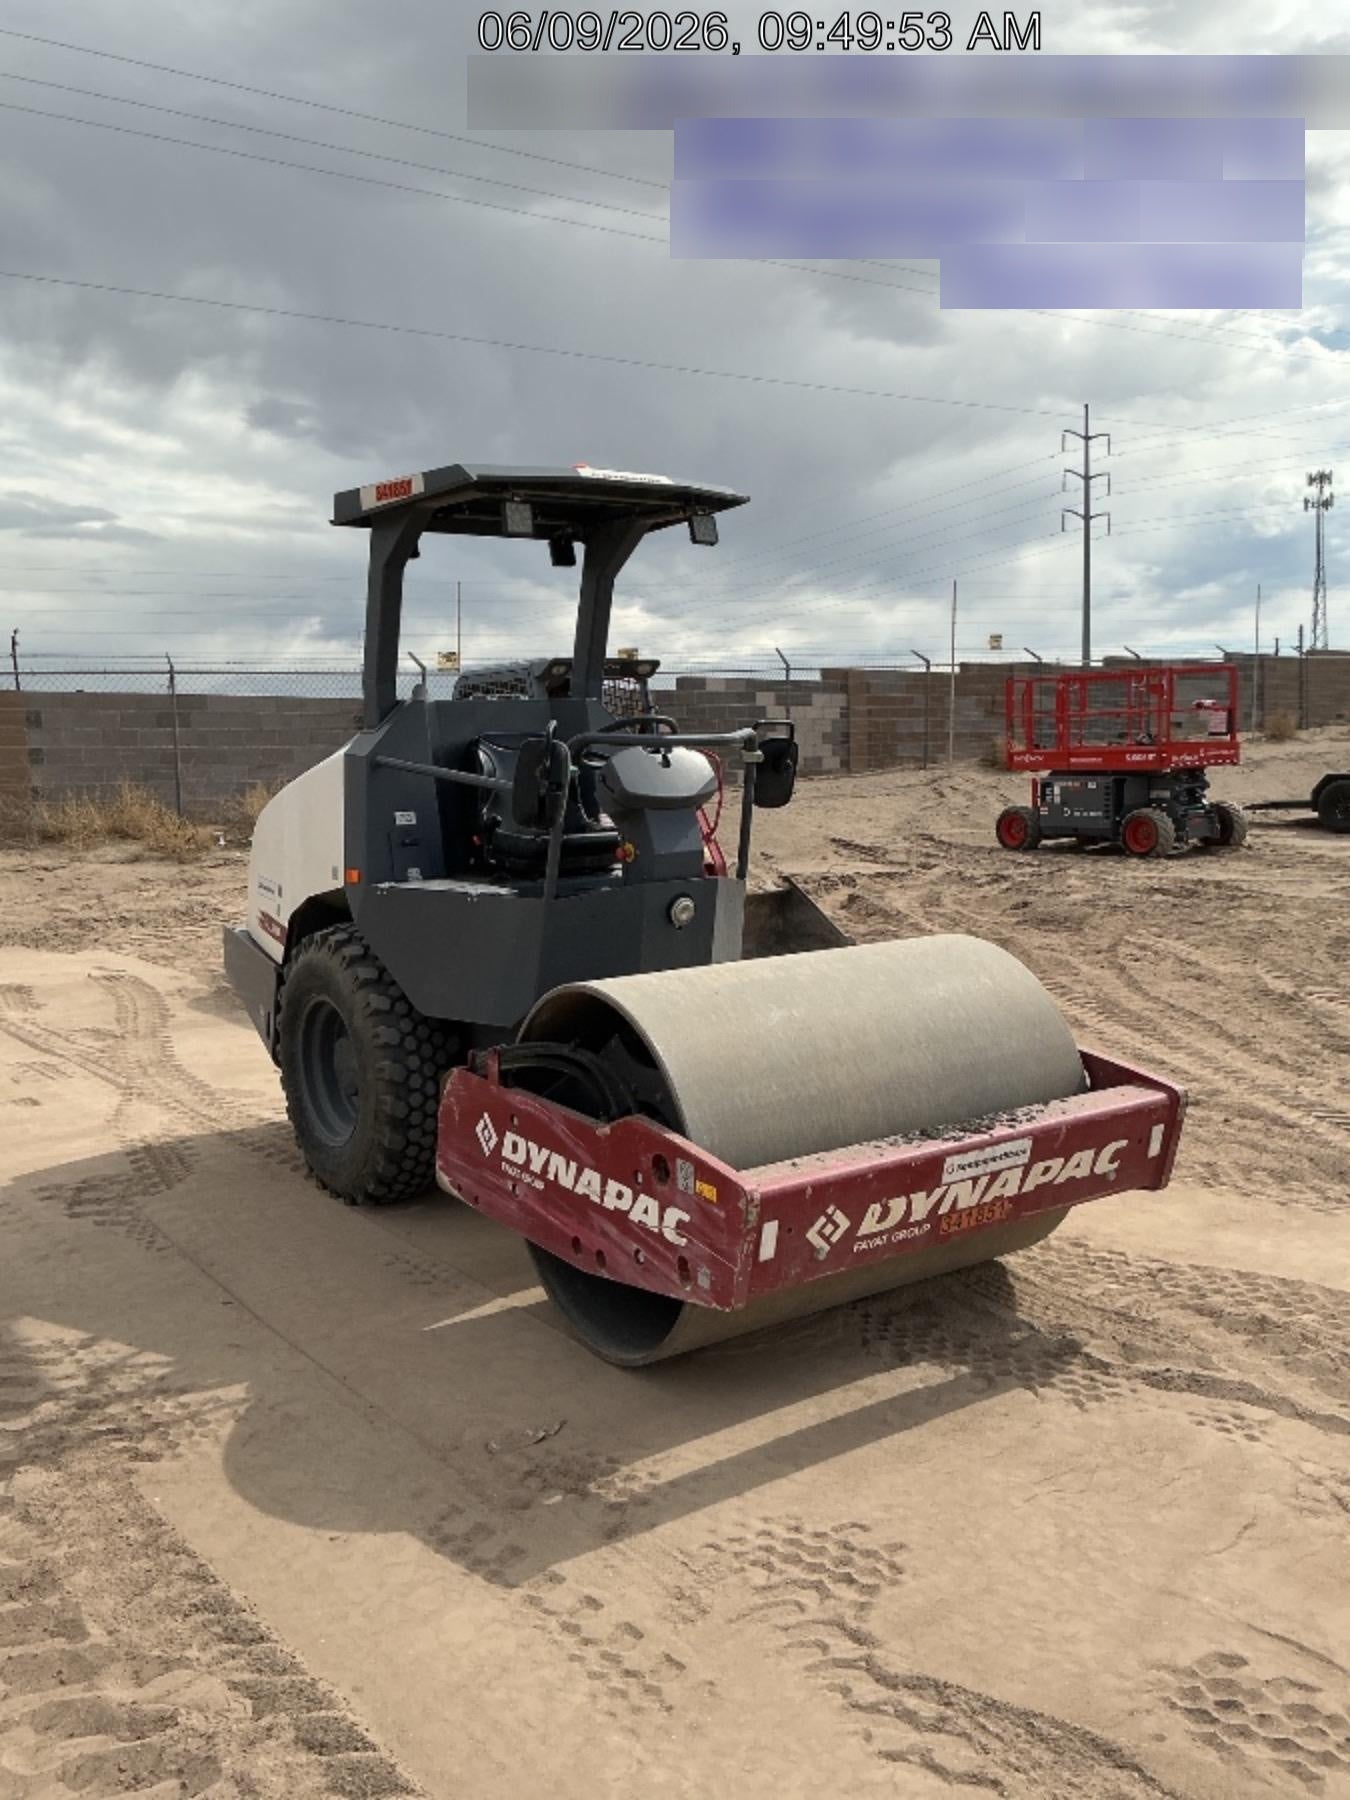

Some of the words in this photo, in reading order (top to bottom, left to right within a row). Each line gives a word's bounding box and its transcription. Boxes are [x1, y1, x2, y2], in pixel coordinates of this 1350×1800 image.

[501, 1130, 691, 1247] DYNAPAC
[856, 1139, 1128, 1237] DYNAPAC
[853, 1234, 888, 1253] FAYAT
[891, 1223, 931, 1243] GROUP
